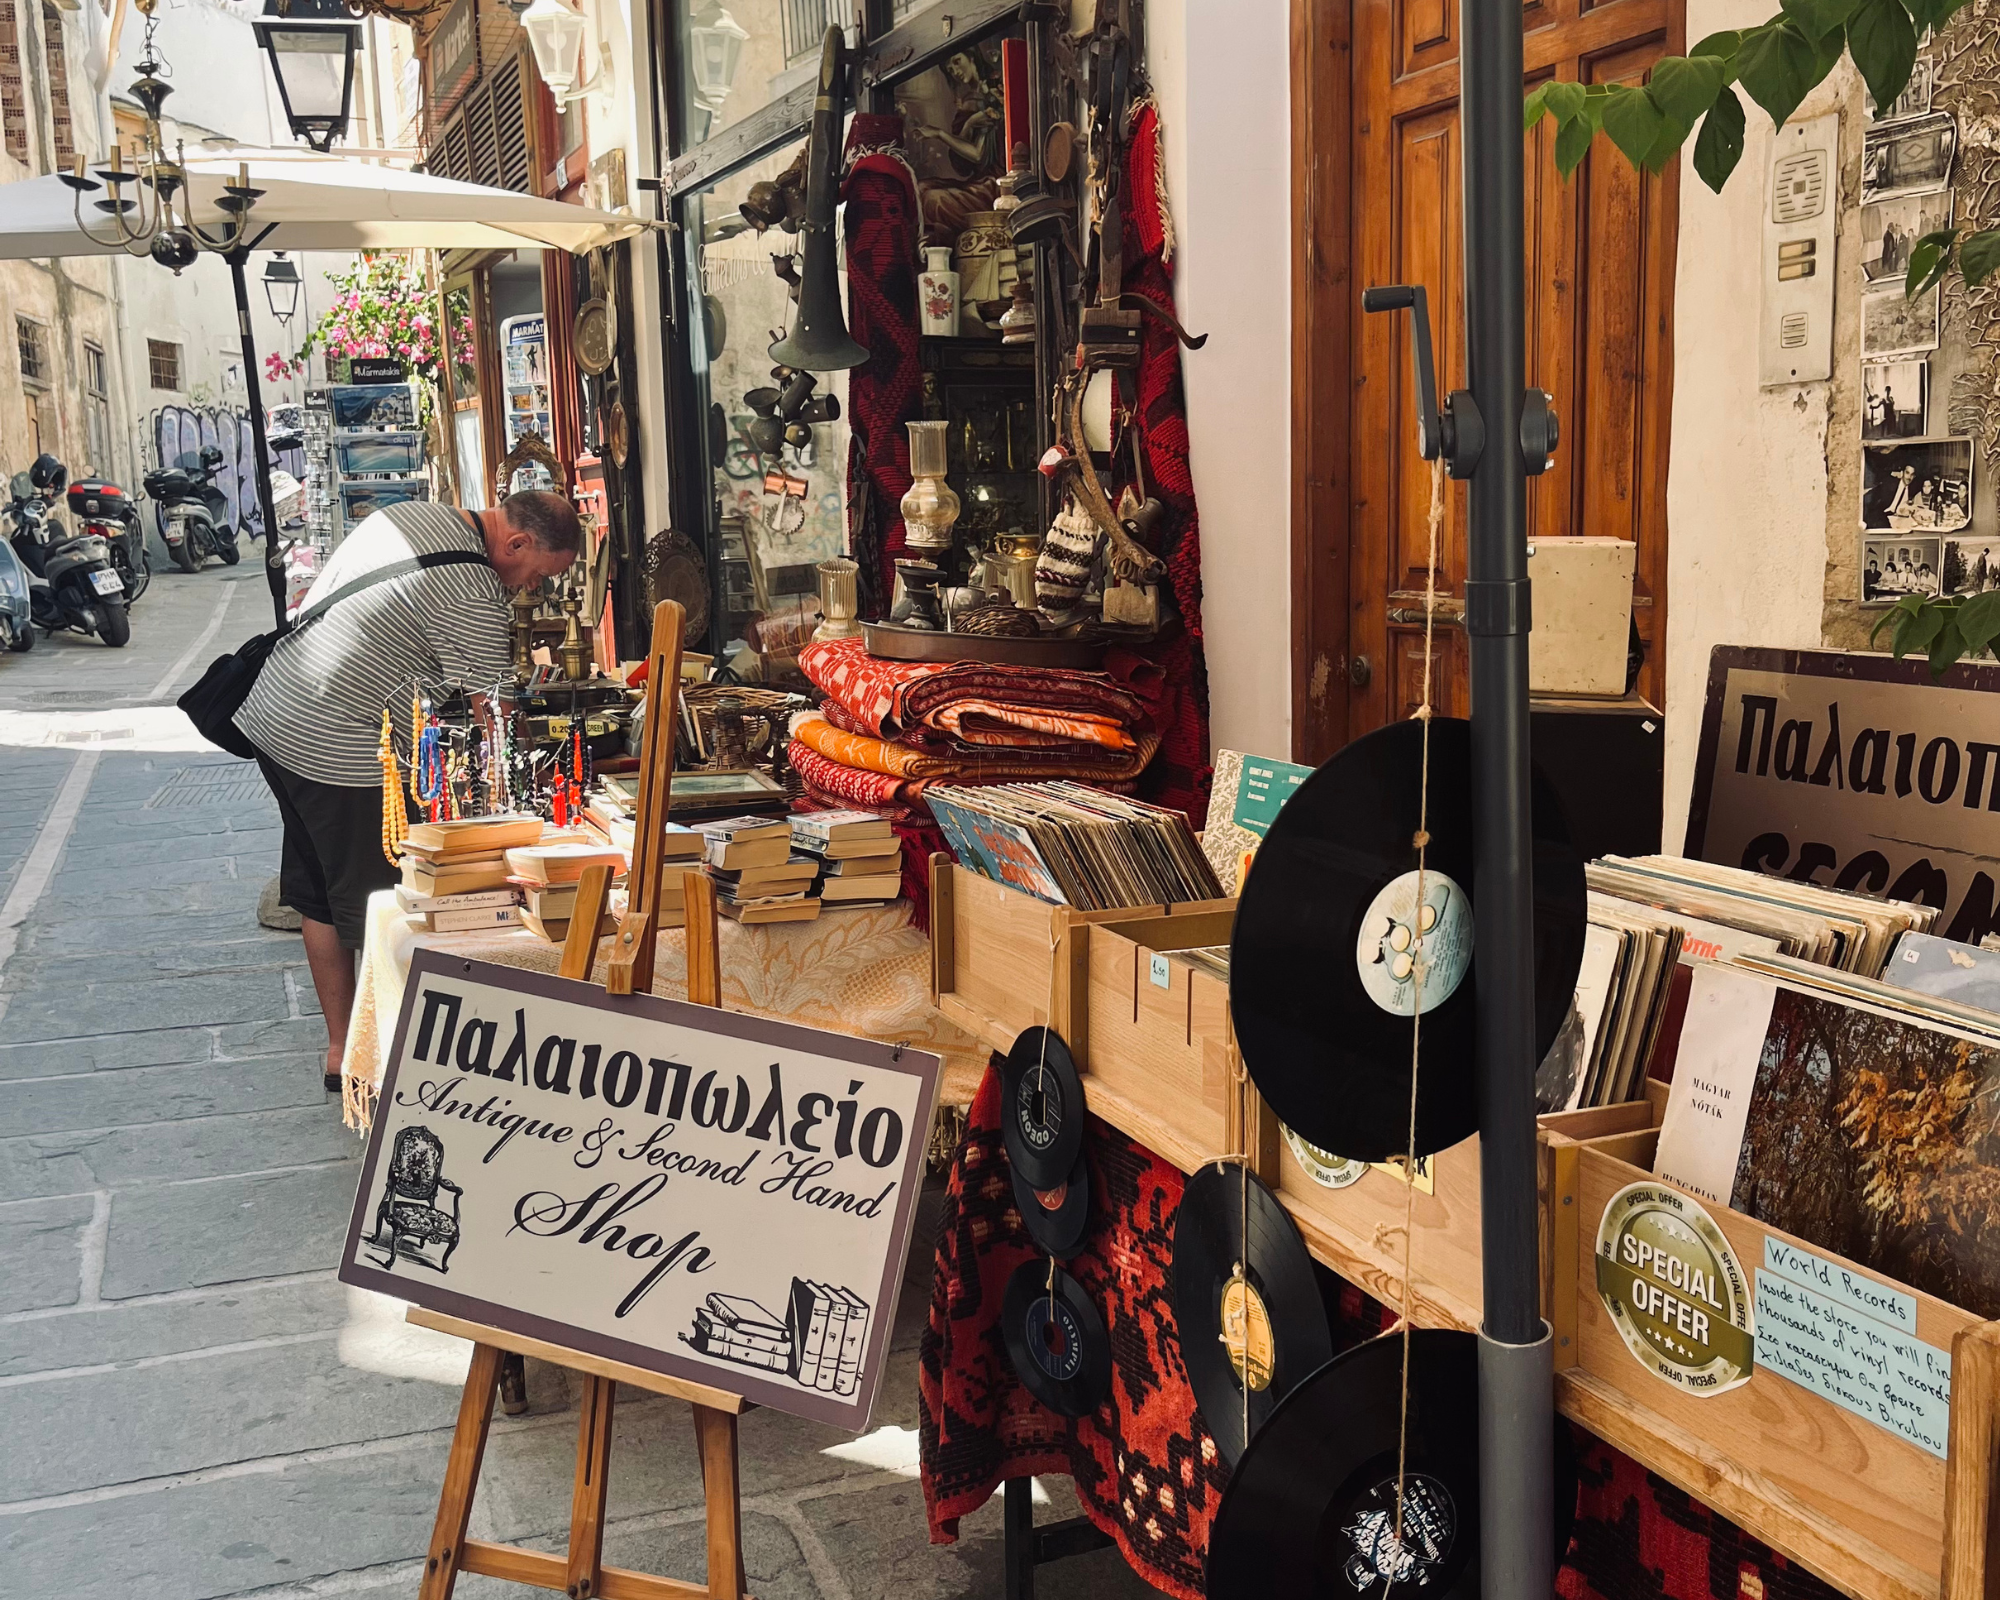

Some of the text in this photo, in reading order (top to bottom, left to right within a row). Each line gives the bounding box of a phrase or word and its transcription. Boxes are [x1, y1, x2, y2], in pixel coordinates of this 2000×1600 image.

[412, 990, 904, 1169] Παλαιοπωλείο
[1690, 1098, 1723, 1119] NÓTÁK
[1692, 1077, 1731, 1100] MAGYAR
[396, 1076, 897, 1220] Antique & Second Hand
[1021, 1109, 1050, 1145] ODEON
[1315, 1169, 1352, 1184] SPECIAL OFFER
[1626, 1190, 1684, 1212] SPECIAL OFFER
[505, 1173, 717, 1319] Shop
[1623, 1232, 1724, 1311] SPECIAL
[1720, 1251, 1742, 1296] SPECIAL
[1767, 1240, 1907, 1320] World Records
[1632, 1278, 1710, 1346] OFFER
[1758, 1277, 1794, 1303] Inside
[1798, 1287, 1819, 1316] the
[1824, 1307, 1859, 1335] store
[1865, 1329, 1887, 1349] you
[1892, 1344, 1920, 1368] will
[1758, 1299, 1826, 1341] thousands
[1832, 1329, 1845, 1352] of
[1851, 1345, 1889, 1375] vinyl
[1658, 1361, 1717, 1387] SPECIAL OFFER
